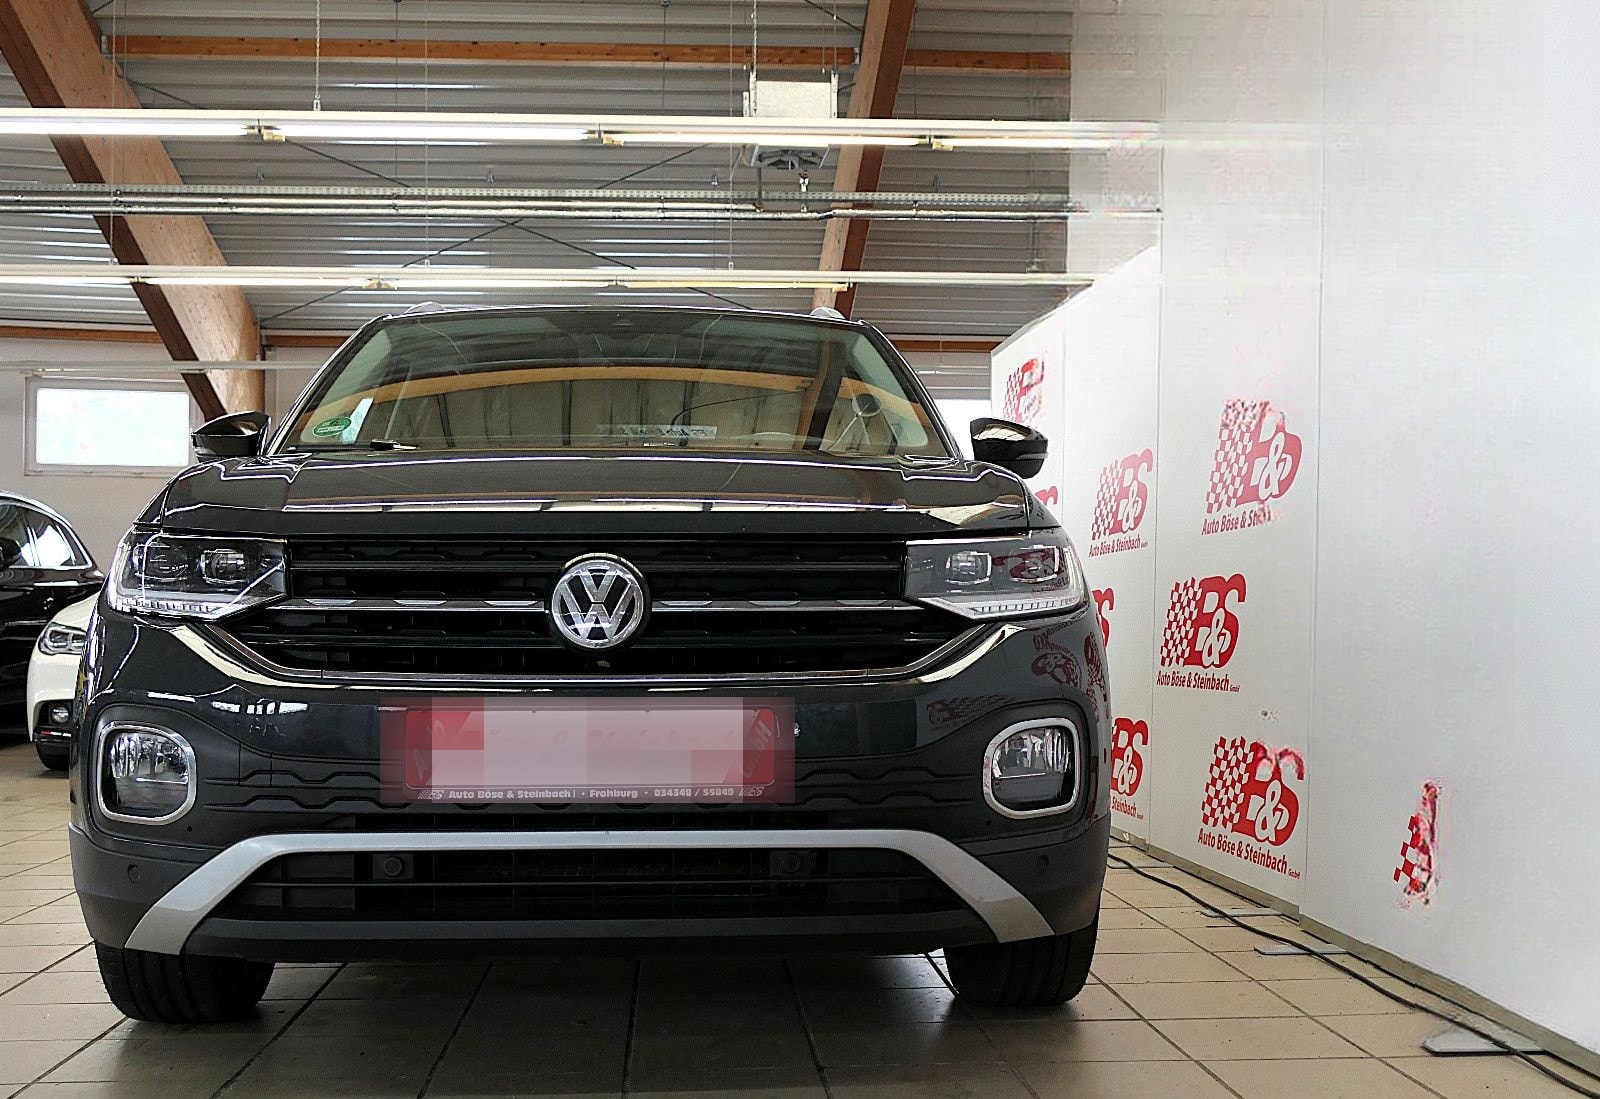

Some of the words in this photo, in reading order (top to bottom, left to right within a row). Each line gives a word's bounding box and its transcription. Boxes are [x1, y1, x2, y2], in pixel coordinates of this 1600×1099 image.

[1201, 518, 1219, 535] Auto
[1220, 513, 1239, 533] Böse
[1240, 510, 1247, 528] &
[1089, 544, 1099, 557] Auto
[1116, 534, 1141, 552] Steinbach
[1156, 670, 1170, 686] Auto
[1170, 671, 1186, 687] Böse
[1186, 672, 1192, 688] &
[1192, 672, 1230, 691] Steinbach
[448, 790, 475, 799] Auto
[506, 790, 514, 799] &
[517, 789, 571, 799] Steinbach
[589, 789, 638, 799] Frohburg
[694, 788, 700, 797] /
[1197, 828, 1216, 848] Auto
[1216, 834, 1236, 855] Böse
[1236, 841, 1243, 858] &
[1243, 843, 1288, 874] Steinbach
